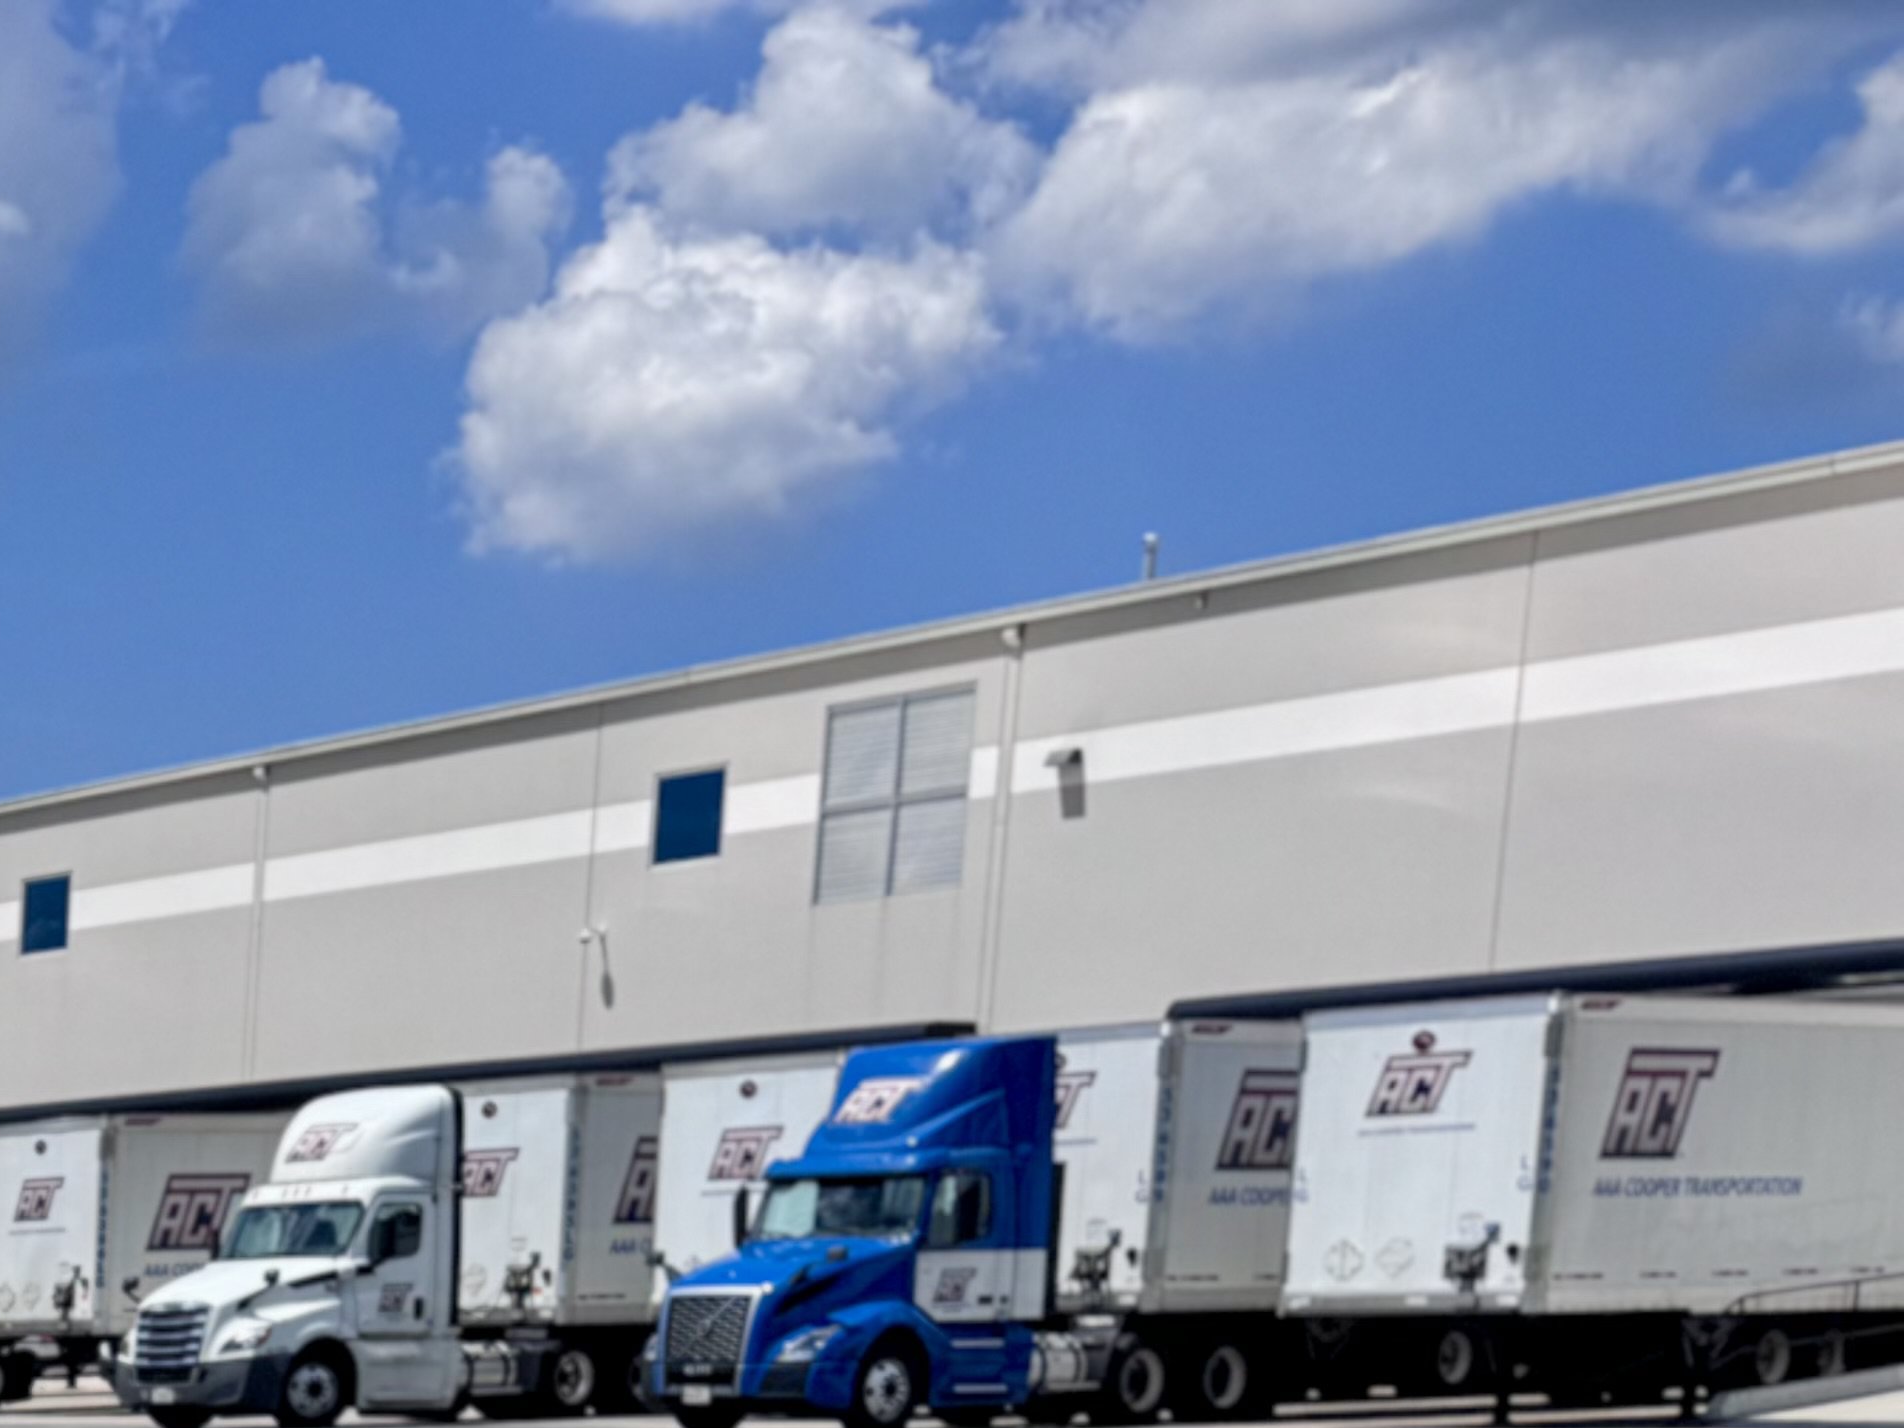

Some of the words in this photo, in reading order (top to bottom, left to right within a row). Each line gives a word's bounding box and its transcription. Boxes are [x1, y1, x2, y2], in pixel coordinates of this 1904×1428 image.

[833, 1078, 922, 1125] ACT
[1365, 1051, 1473, 1117] ACT
[1599, 1047, 1720, 1159] ACT
[708, 1125, 783, 1181] ACT
[14, 1177, 64, 1222] ACT
[146, 1173, 251, 1250] ACT
[1685, 1176, 1803, 1197] TRANSPORTATION
